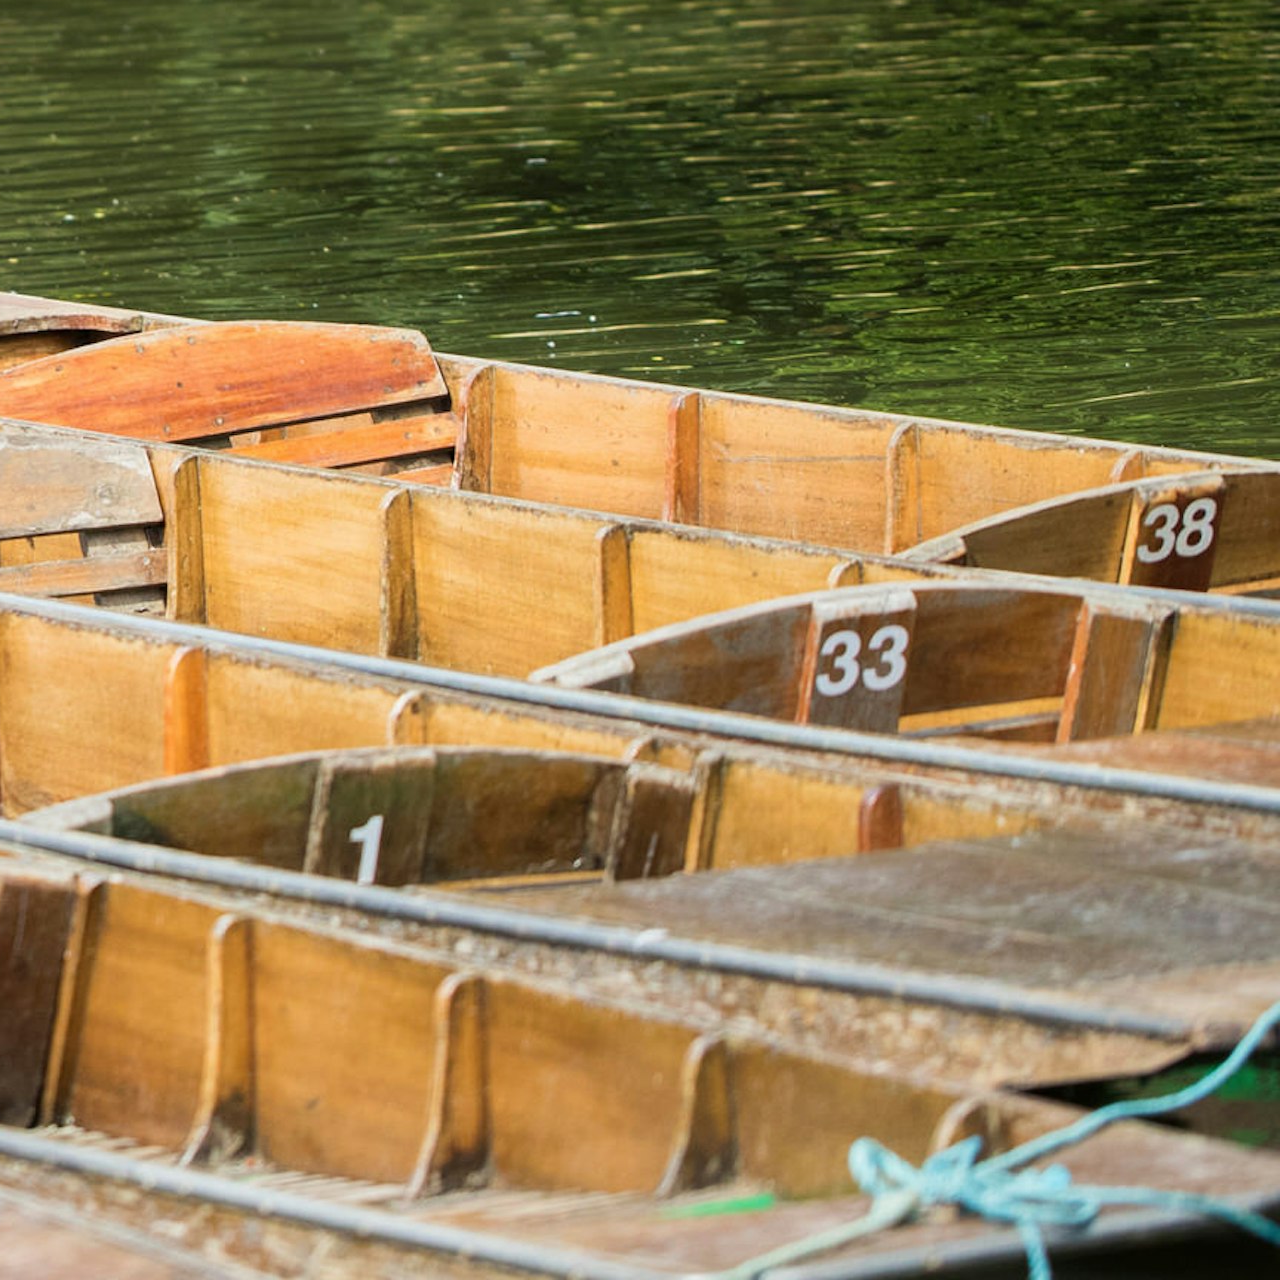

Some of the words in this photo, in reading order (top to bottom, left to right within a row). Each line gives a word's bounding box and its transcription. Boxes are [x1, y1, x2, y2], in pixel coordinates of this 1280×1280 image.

[1137, 497, 1217, 563] 38
[816, 625, 909, 696] 33
[349, 815, 384, 885] 1
